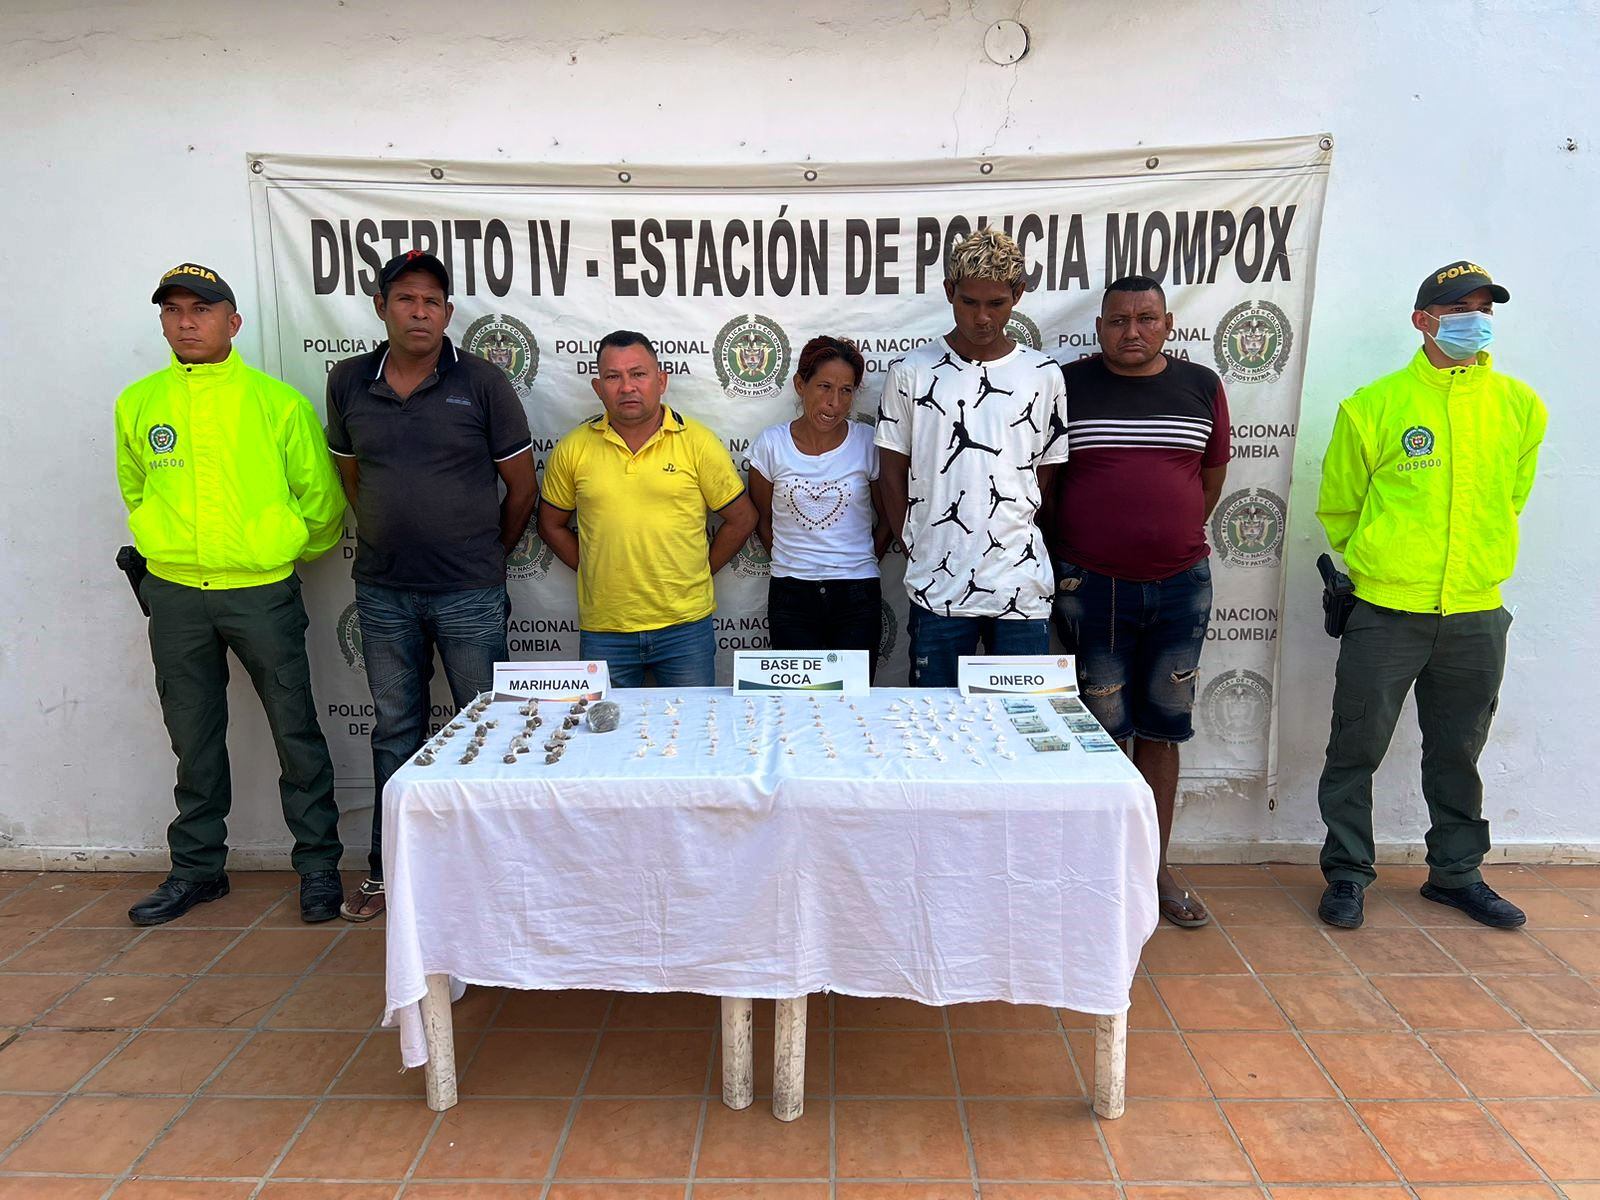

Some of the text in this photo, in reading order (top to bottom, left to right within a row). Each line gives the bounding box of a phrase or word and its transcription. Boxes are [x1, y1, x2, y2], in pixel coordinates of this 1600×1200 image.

[527, 219, 570, 297] IV
[611, 204, 829, 298] ESTACIÓN
[845, 217, 900, 296] DE
[916, 213, 1090, 295] POCIA
[1105, 204, 1298, 289] MOMPOX
[1223, 314, 1244, 347] REPUBLICA
[1266, 313, 1282, 346] COLOMBIA
[303, 339, 368, 352] POLICIA
[510, 327, 530, 360] COLOMBIA
[723, 327, 742, 361] REPUBLICA
[762, 327, 782, 361] COLOMBIA
[658, 361, 690, 374] BIA
[1226, 352, 1278, 373] POLICIA NACIONAL
[726, 366, 779, 388] POLICIA NACIONAL
[1251, 372, 1271, 381] PATRIA
[753, 386, 773, 395] PATRIA
[1264, 500, 1283, 532] COLOMBIA
[1225, 540, 1279, 558] POLICIA NACIONAL
[1216, 608, 1278, 621] NACION
[508, 620, 579, 632] ACIONAL
[509, 639, 562, 652] OMBIA
[760, 660, 822, 670] BASE DE
[509, 680, 590, 690] MARIHUANA
[770, 674, 812, 684] COCA
[990, 675, 1044, 686] DINERO
[349, 723, 369, 735] DE
